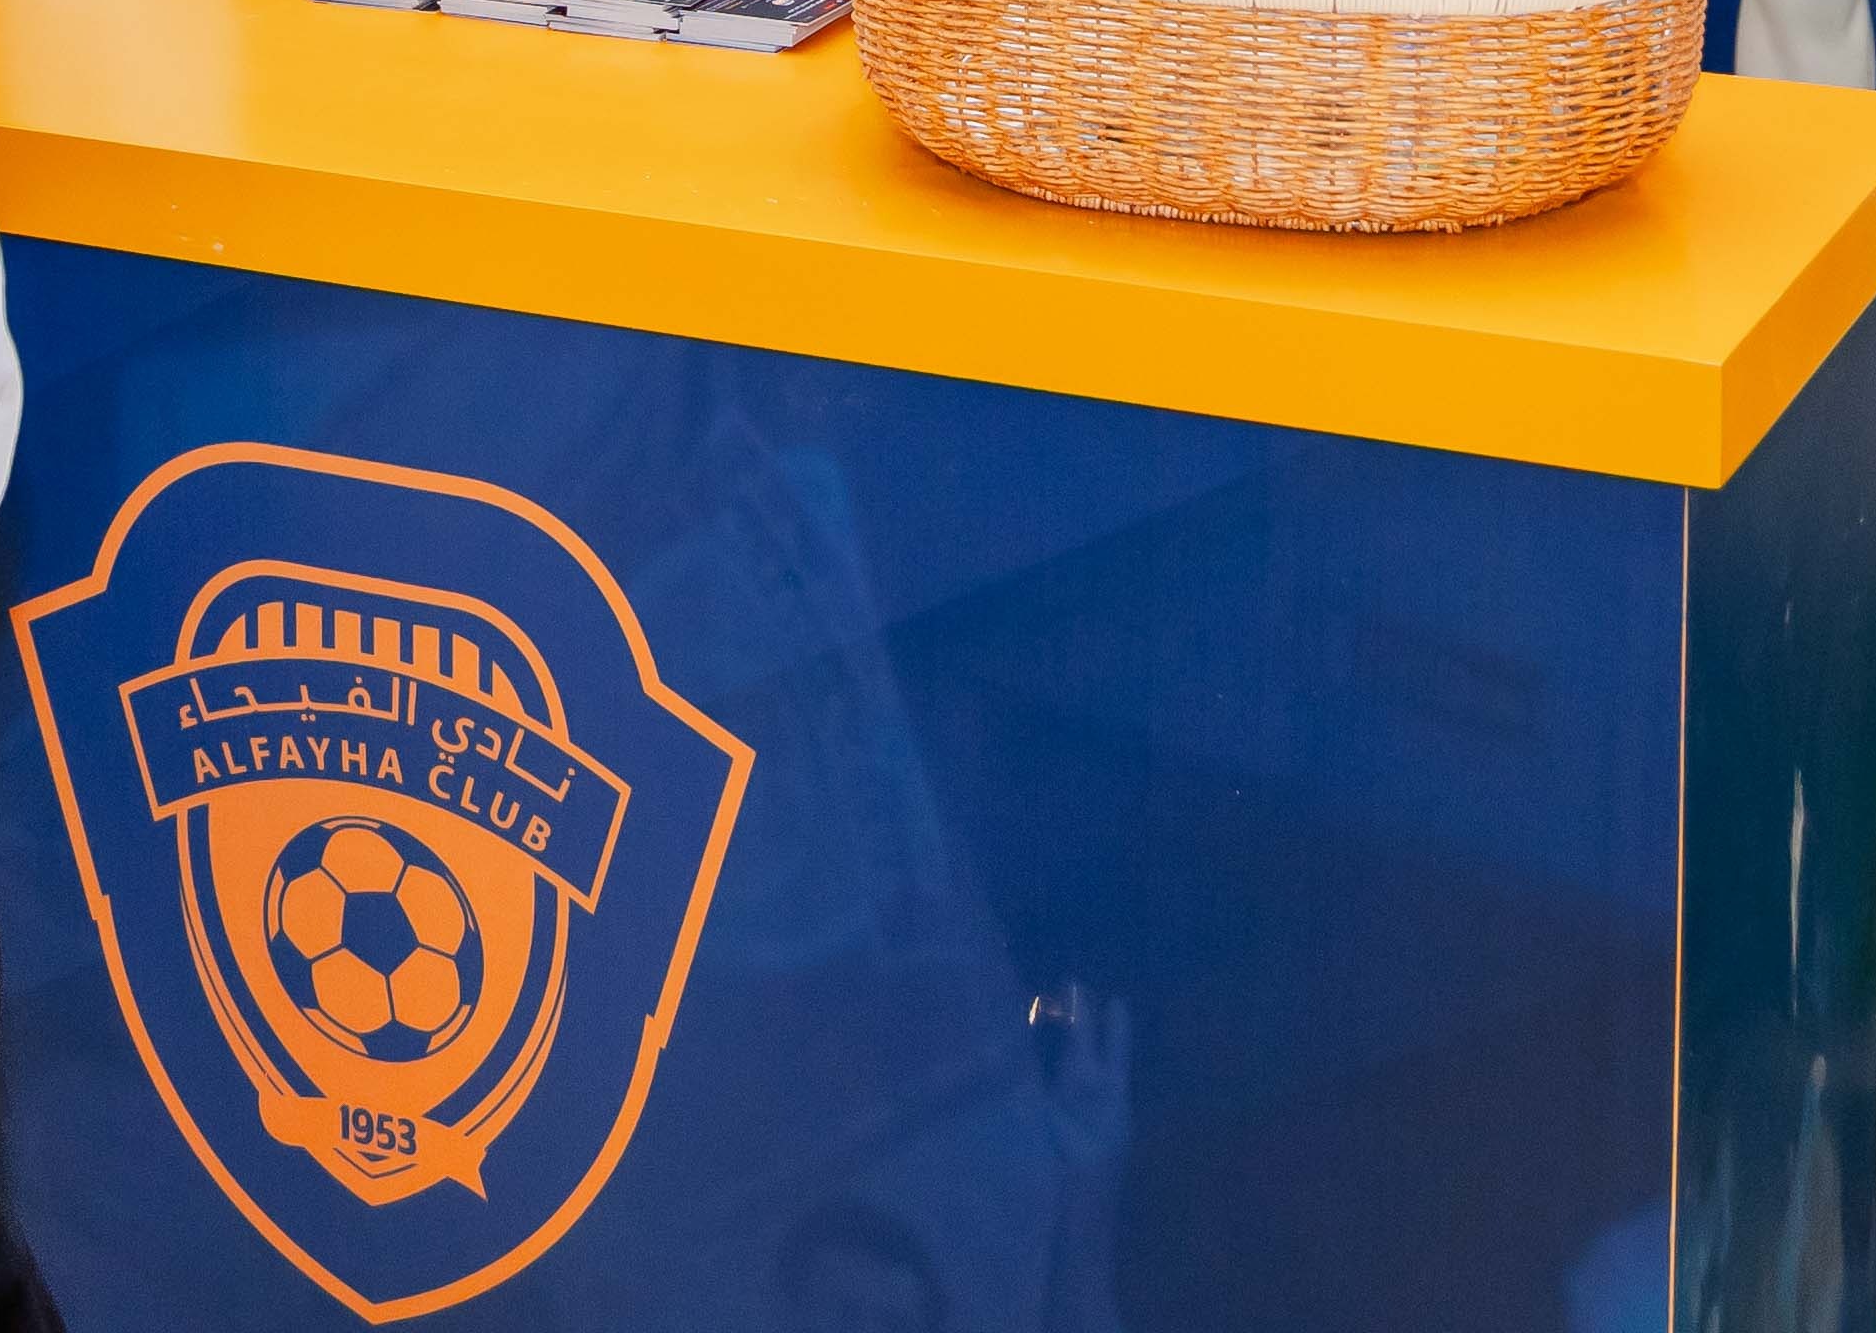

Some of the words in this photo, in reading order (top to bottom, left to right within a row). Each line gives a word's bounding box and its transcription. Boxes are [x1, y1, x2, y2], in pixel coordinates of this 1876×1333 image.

[179, 676, 417, 730] الفيحاء
[193, 735, 404, 784] ALFAYHA
[428, 765, 552, 852] CLUB
[431, 717, 576, 803] نادي
[340, 1104, 417, 1155] 1953
